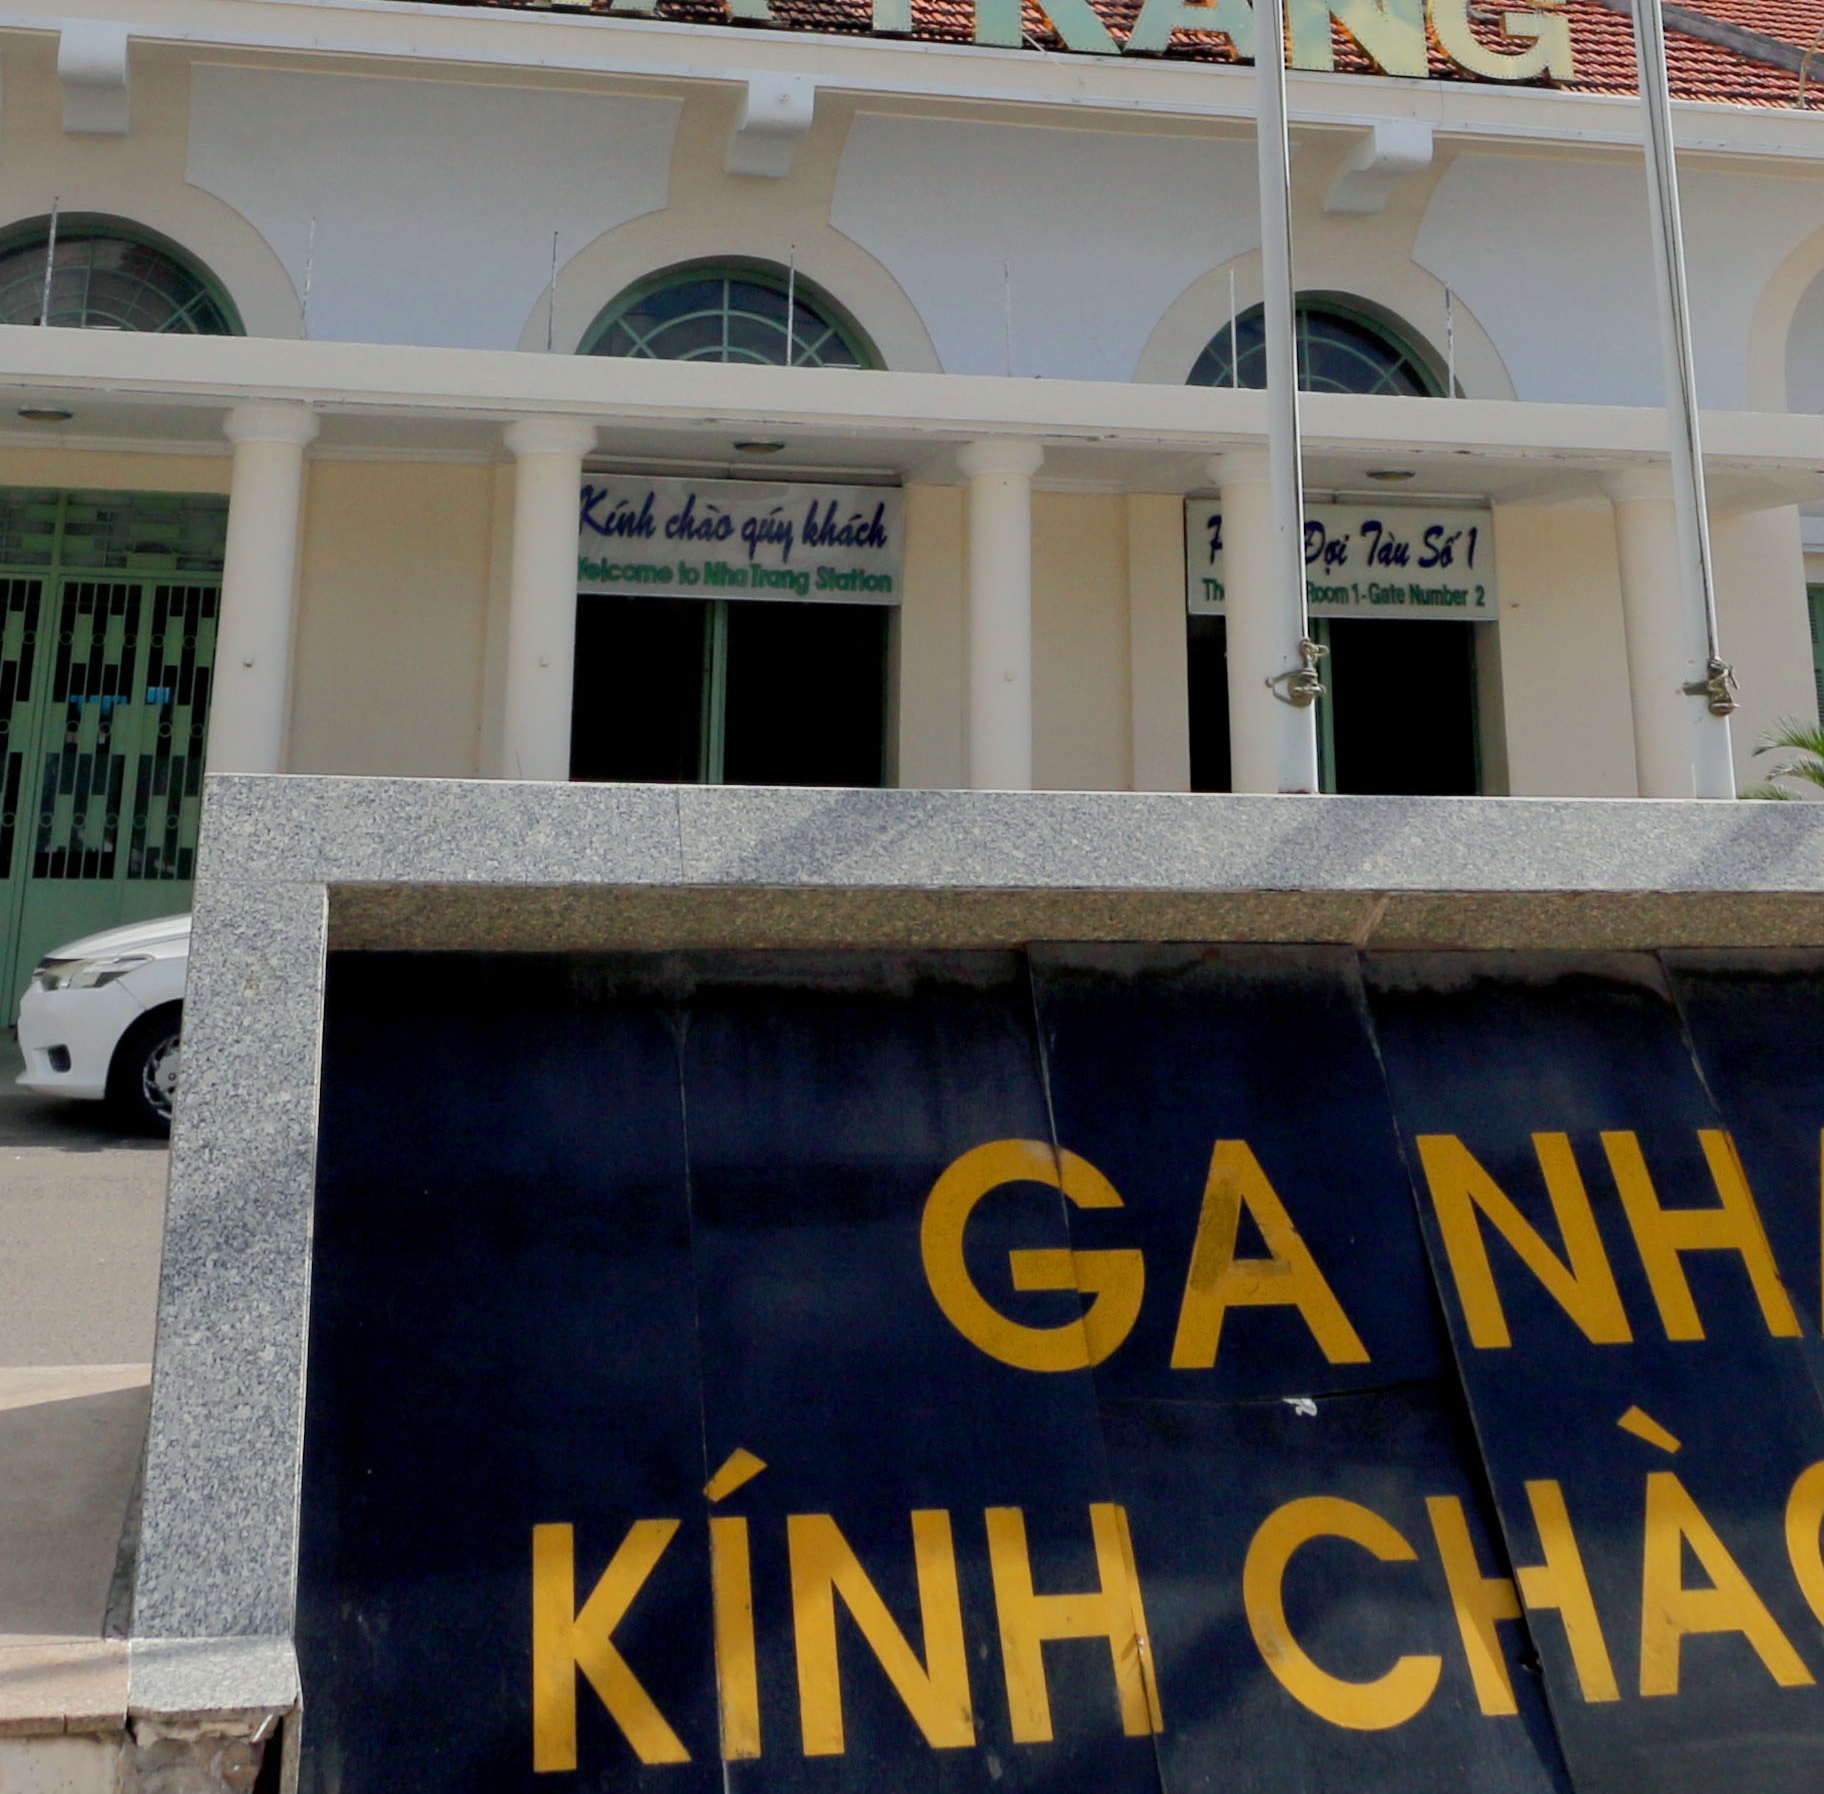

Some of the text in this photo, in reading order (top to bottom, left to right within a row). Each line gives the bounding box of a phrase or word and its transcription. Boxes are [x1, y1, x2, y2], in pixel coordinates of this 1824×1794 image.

[579, 484, 887, 564] Kính chào quý khách
[1361, 520, 1410, 567] Tàu
[1418, 525, 1463, 568] Số
[678, 560, 701, 586] to
[815, 566, 893, 593] Station
[1409, 583, 1469, 607] Number
[1475, 585, 1486, 607] 2
[920, 1138, 1371, 1373] GA
[532, 1447, 1164, 1773] KÍNH
